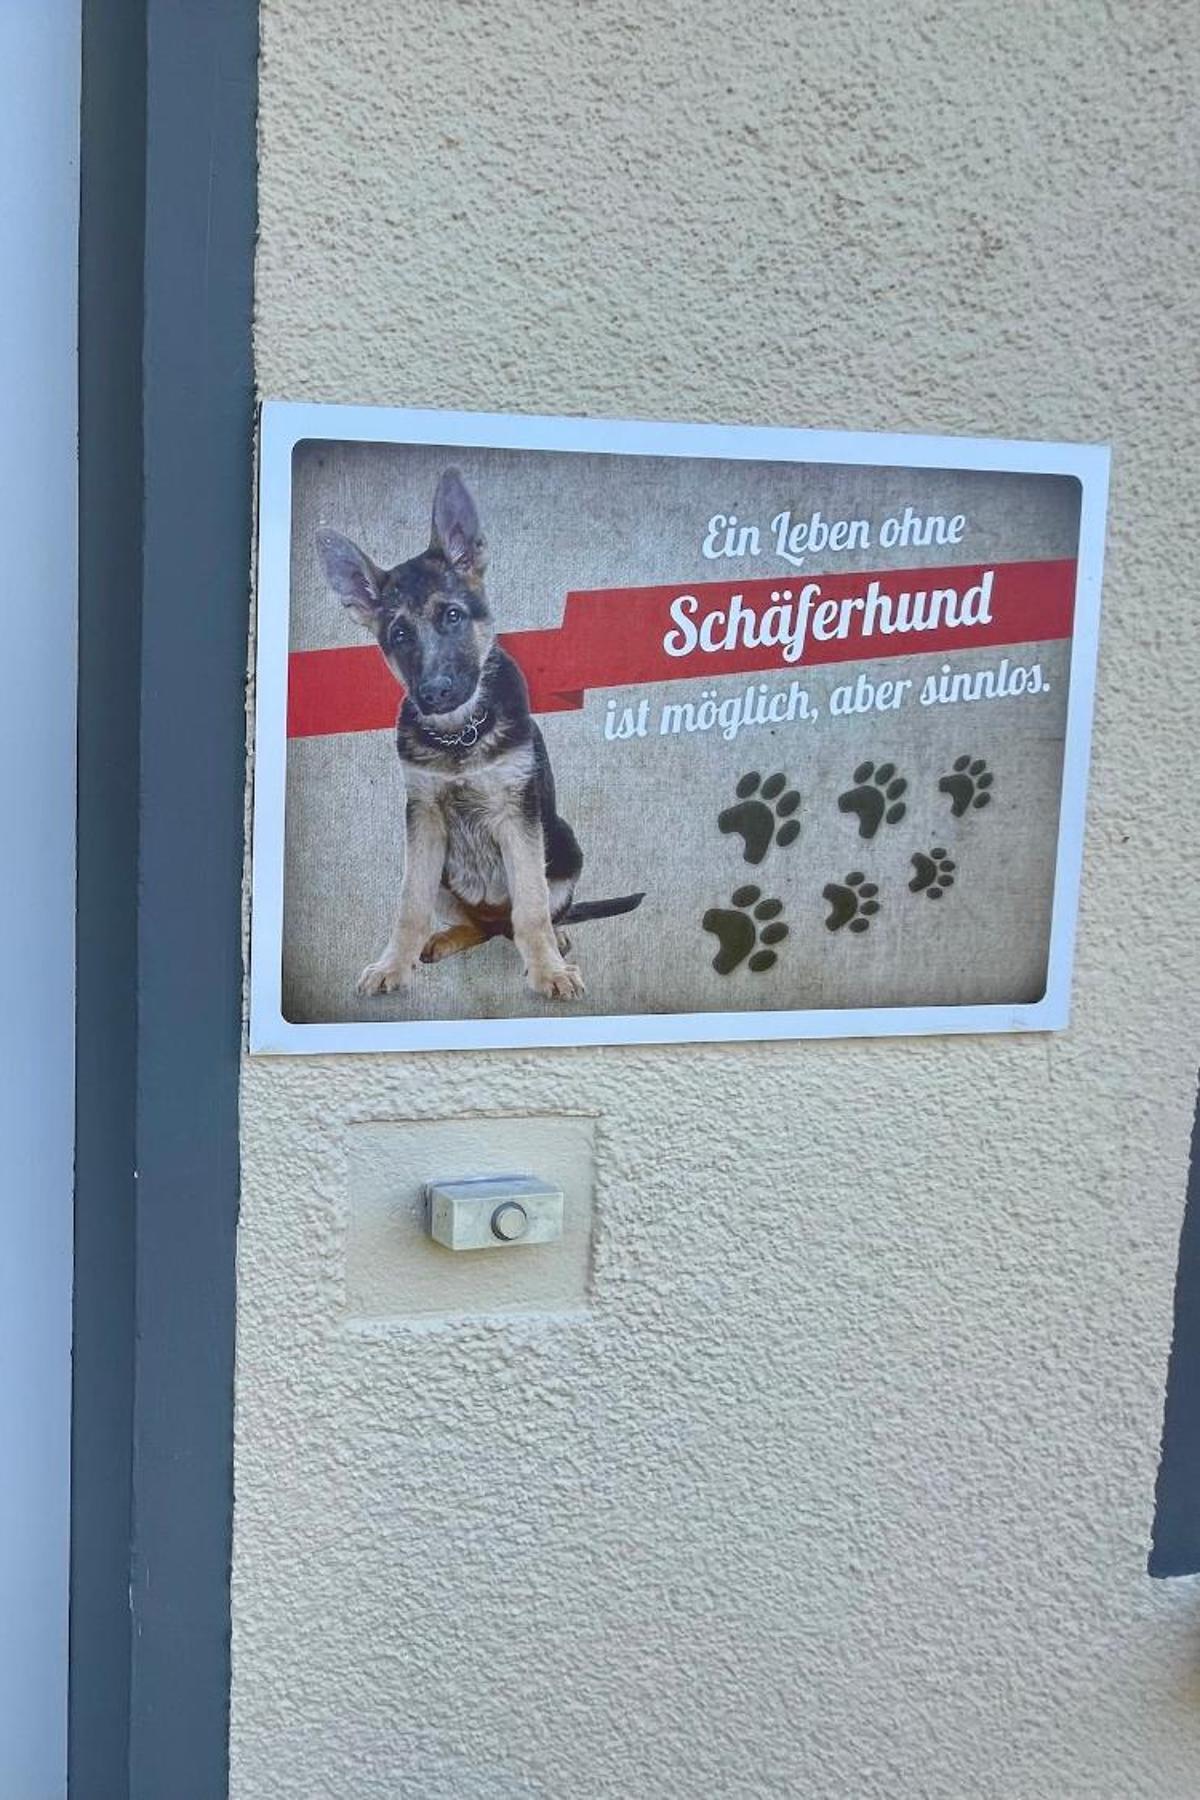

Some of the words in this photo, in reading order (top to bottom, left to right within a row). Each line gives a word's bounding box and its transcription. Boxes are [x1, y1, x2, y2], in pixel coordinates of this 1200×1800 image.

[702, 515, 760, 560] Ein
[771, 511, 870, 566] Leben
[879, 508, 966, 546] ohne
[663, 571, 995, 663] Schäferhund
[603, 701, 648, 741] ist
[660, 683, 820, 740] möglich,
[830, 679, 912, 716] aber
[920, 659, 1051, 706] sinnlos.
